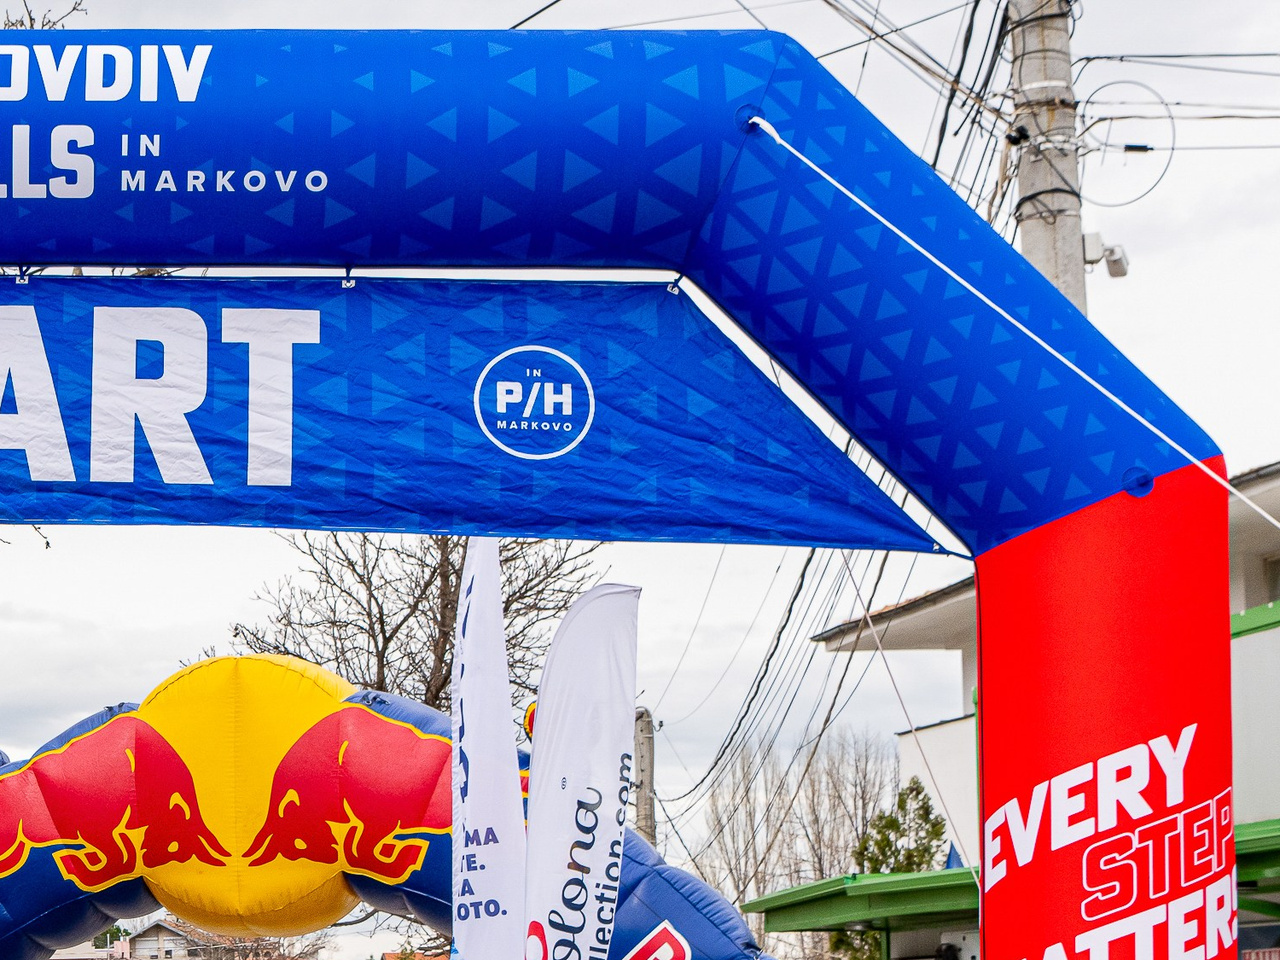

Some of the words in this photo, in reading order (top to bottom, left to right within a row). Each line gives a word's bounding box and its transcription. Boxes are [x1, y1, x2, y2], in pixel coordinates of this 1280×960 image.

[120, 134, 161, 157] IN
[120, 169, 329, 193] MARKOVO
[526, 368, 541, 377] IN
[496, 381, 572, 418] P/H
[497, 421, 572, 431] MARKOVO
[984, 723, 1198, 893] EVERY
[1081, 787, 1234, 921] STEP
